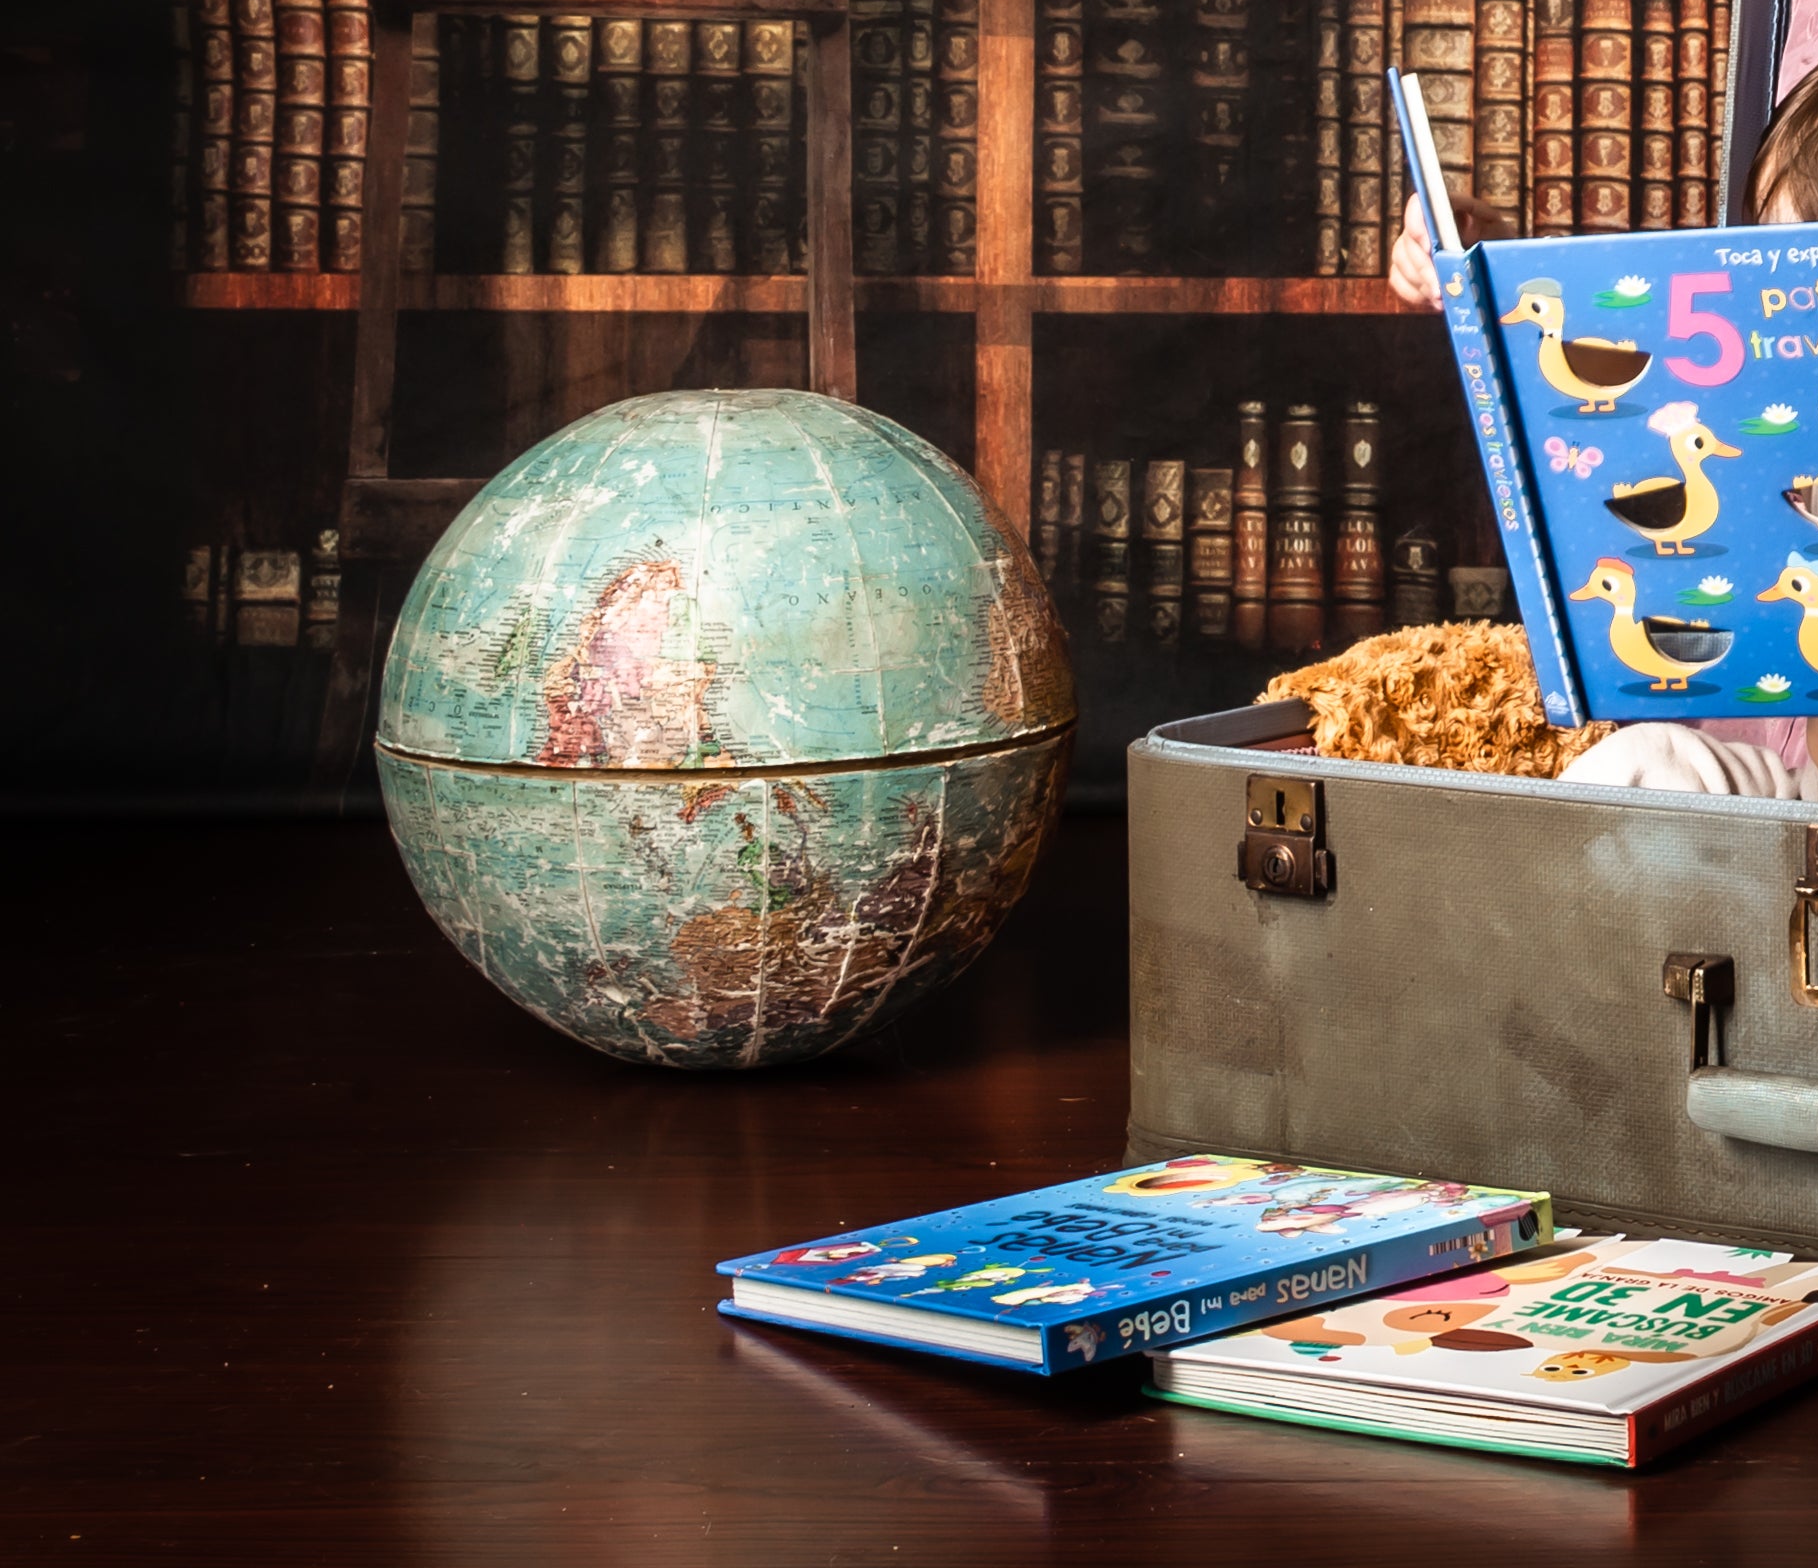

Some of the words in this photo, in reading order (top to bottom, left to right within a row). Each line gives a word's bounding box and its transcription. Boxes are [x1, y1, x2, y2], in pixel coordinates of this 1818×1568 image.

[1714, 246, 1762, 267] Toca
[1767, 248, 1781, 272] y
[1662, 270, 1746, 388] 5
[1463, 363, 1497, 437] patitos
[1486, 441, 1520, 531] traviesos
[986, 1211, 1157, 1242] Bebé
[968, 1232, 1187, 1271] Nanas
[1276, 1253, 1368, 1304] Nanas
[1579, 1272, 1658, 1287] GRANJA
[1659, 1281, 1679, 1290] LA
[1684, 1285, 1709, 1294] DE
[1200, 1295, 1222, 1316] mi
[1229, 1282, 1266, 1307] para
[1549, 1281, 1653, 1307] 3D
[1708, 1289, 1791, 1305] AMIGOS
[1652, 1291, 1770, 1324] EN
[1118, 1299, 1191, 1349] Bebé
[1481, 1318, 1515, 1329] Y
[1511, 1301, 1726, 1340] BÚSCAME
[1516, 1321, 1596, 1340] BIEN
[1601, 1330, 1685, 1352] MIRA
[1663, 1406, 1687, 1431] MIRA
